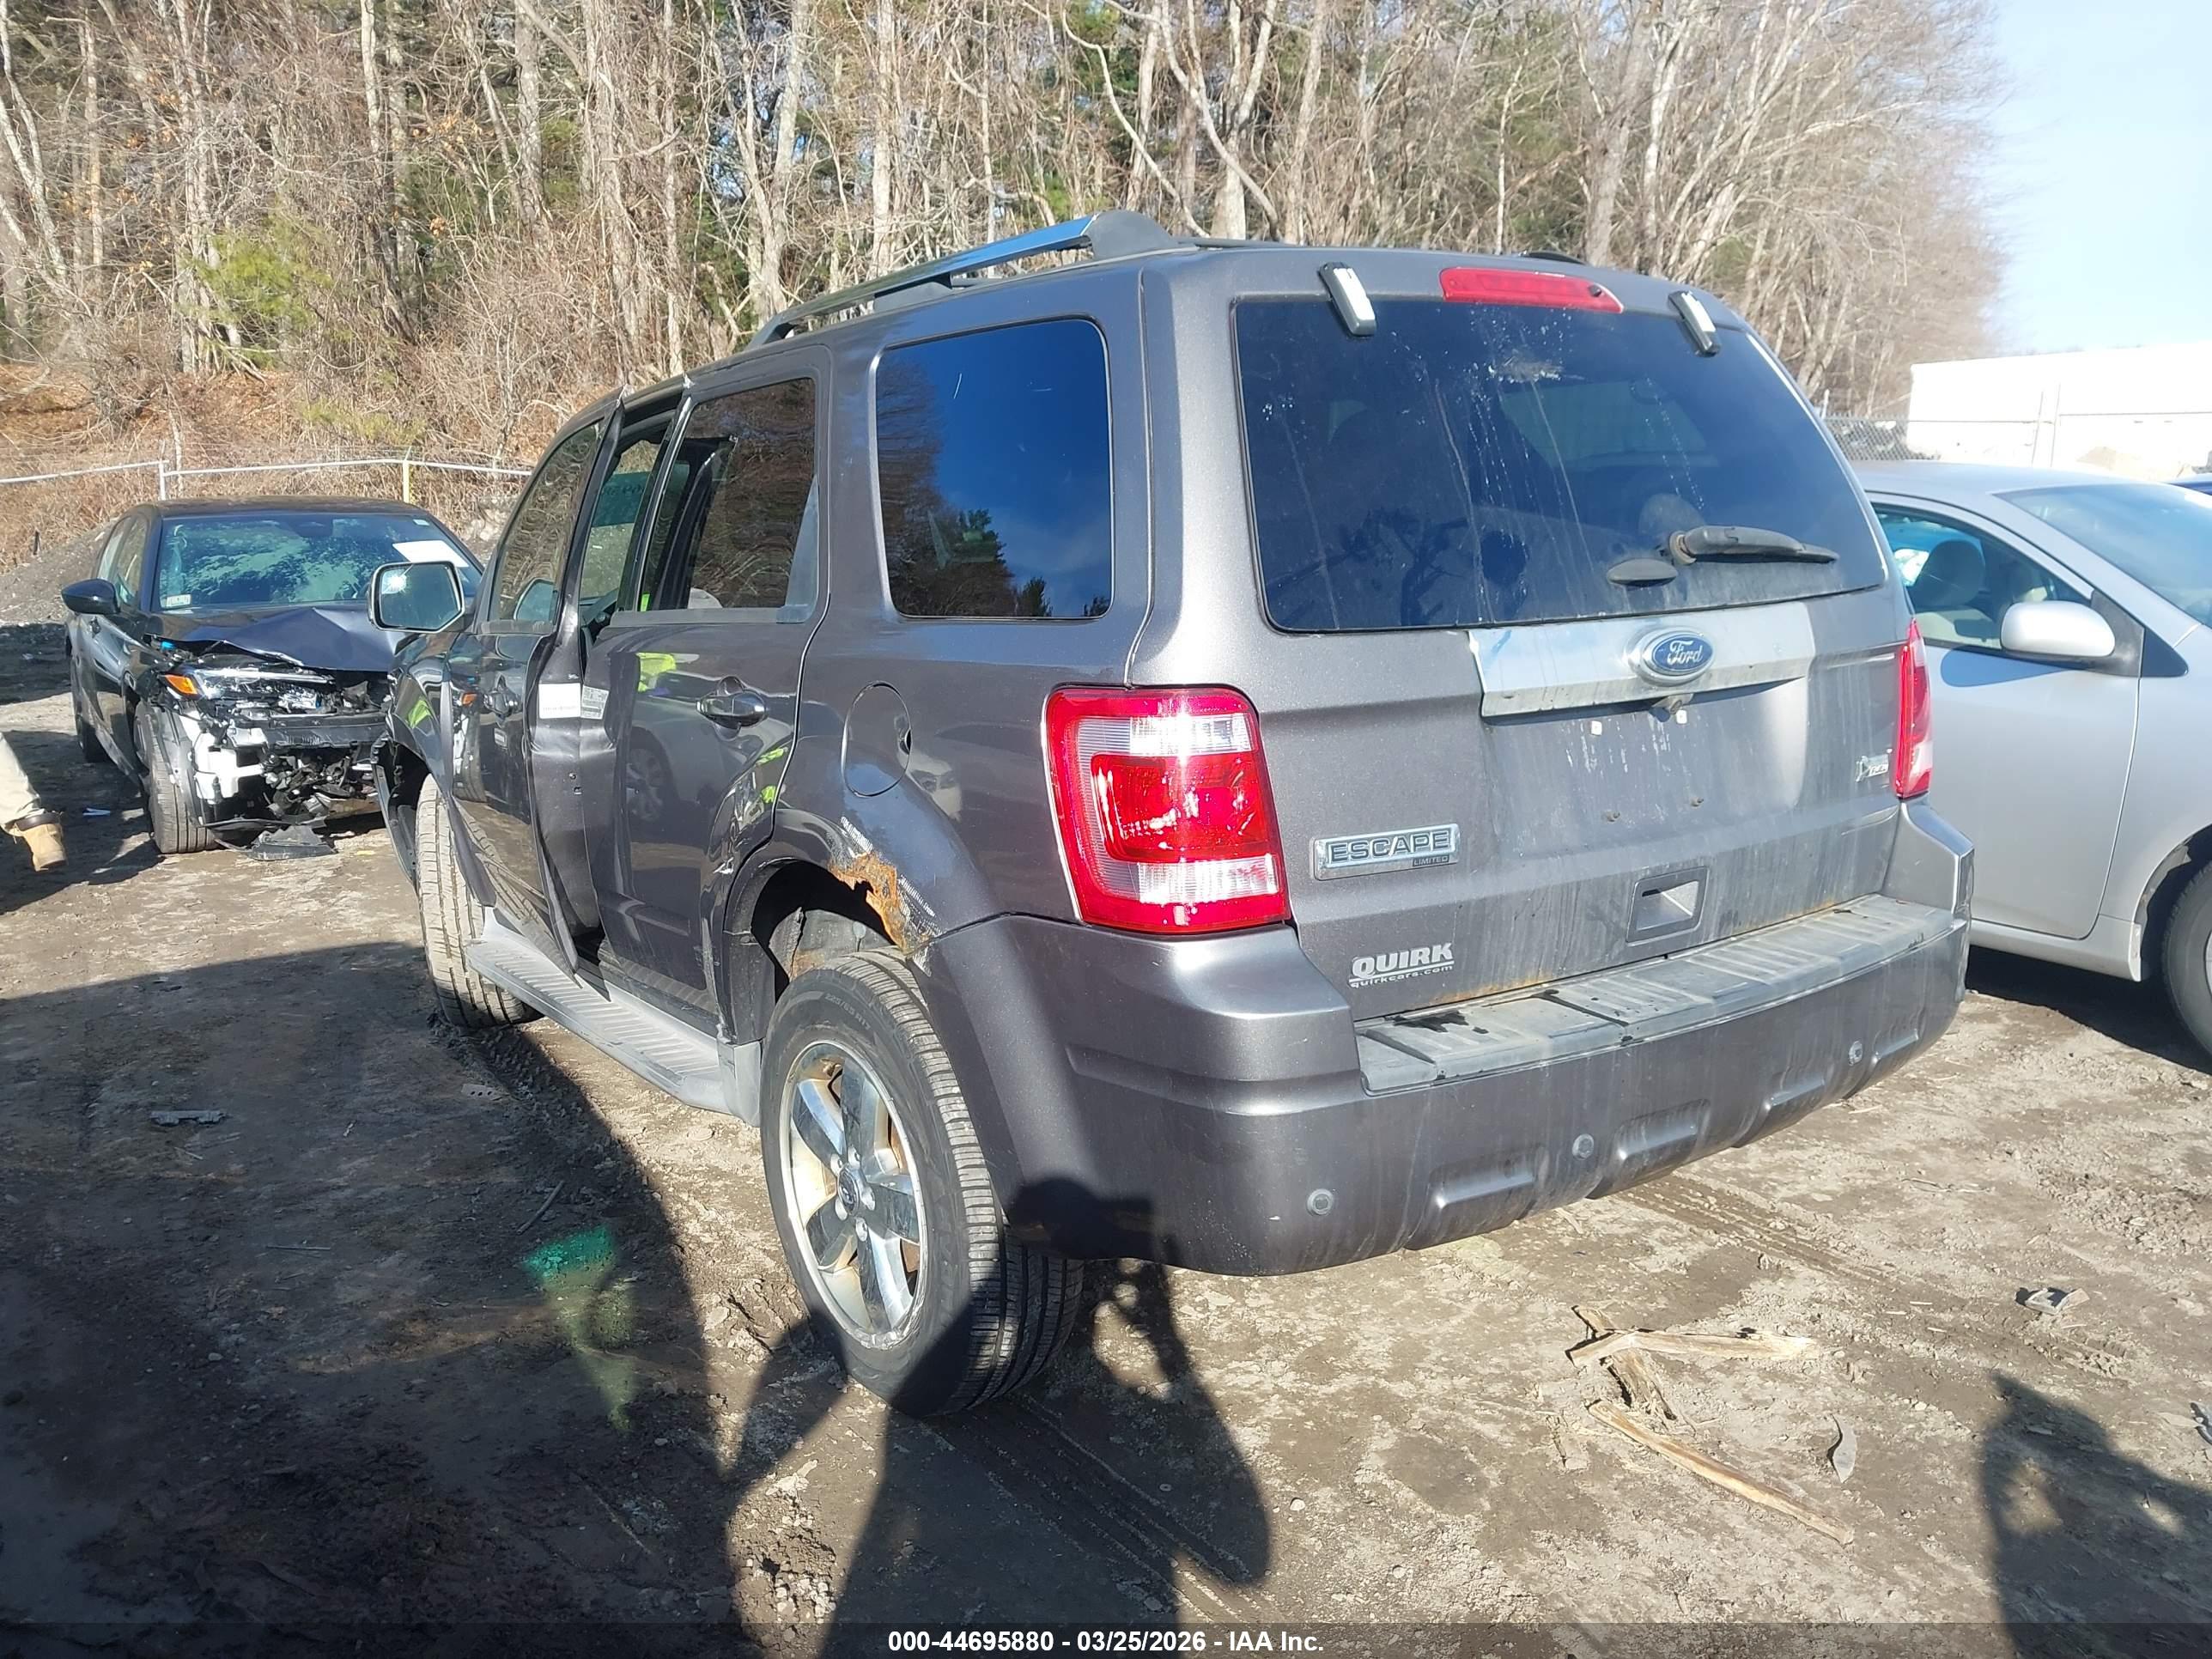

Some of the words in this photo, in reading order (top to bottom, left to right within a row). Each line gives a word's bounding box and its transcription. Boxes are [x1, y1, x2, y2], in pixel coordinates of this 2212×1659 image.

[1667, 640, 1703, 665] Ford
[1330, 831, 1449, 862] ESCAPE
[1413, 855, 1449, 866] LIMITED
[1352, 943, 1454, 979] QUIRK
[1350, 965, 1453, 988] quirkcars.com
